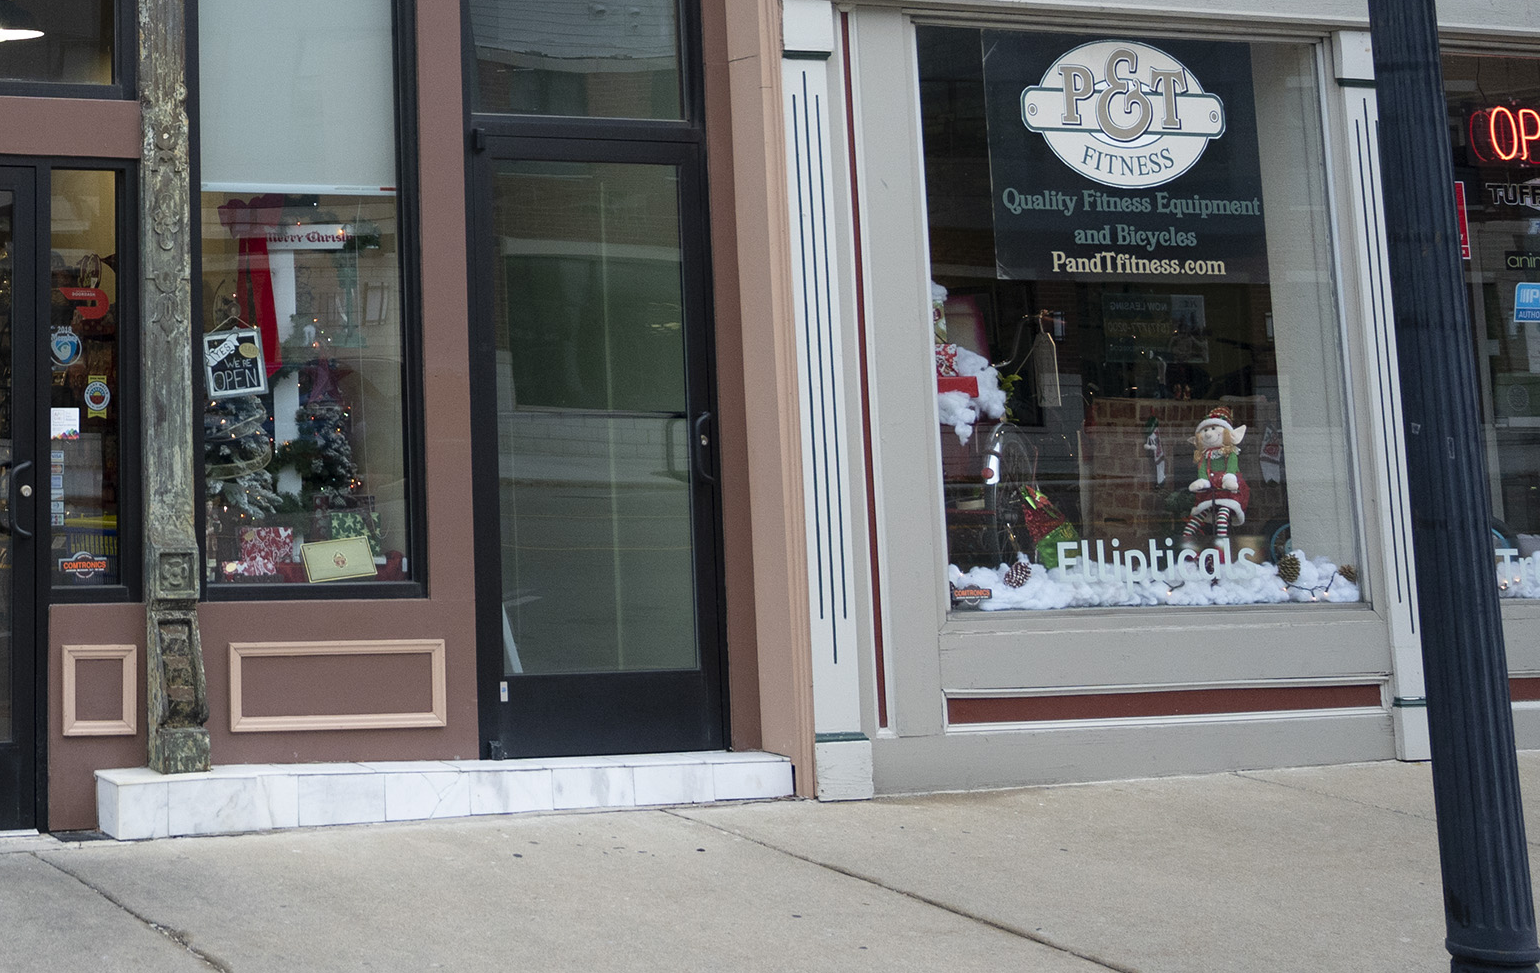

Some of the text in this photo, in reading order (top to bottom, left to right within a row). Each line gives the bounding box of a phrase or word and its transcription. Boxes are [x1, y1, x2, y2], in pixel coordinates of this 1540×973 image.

[1058, 47, 1189, 143] P&T
[1081, 144, 1175, 176] FITNESS
[1002, 187, 1261, 218] Quality Fitness Equipment
[1074, 224, 1197, 251] and Bicycles
[1051, 251, 1226, 275] PandTfitness.com
[215, 343, 231, 358] YES
[213, 368, 258, 392] OPEN
[63, 561, 107, 570] COMTRONICS
[1057, 537, 1256, 593] Ellipticals
[1494, 548, 1540, 586] Tr
[954, 589, 990, 597] COMTRONICS
